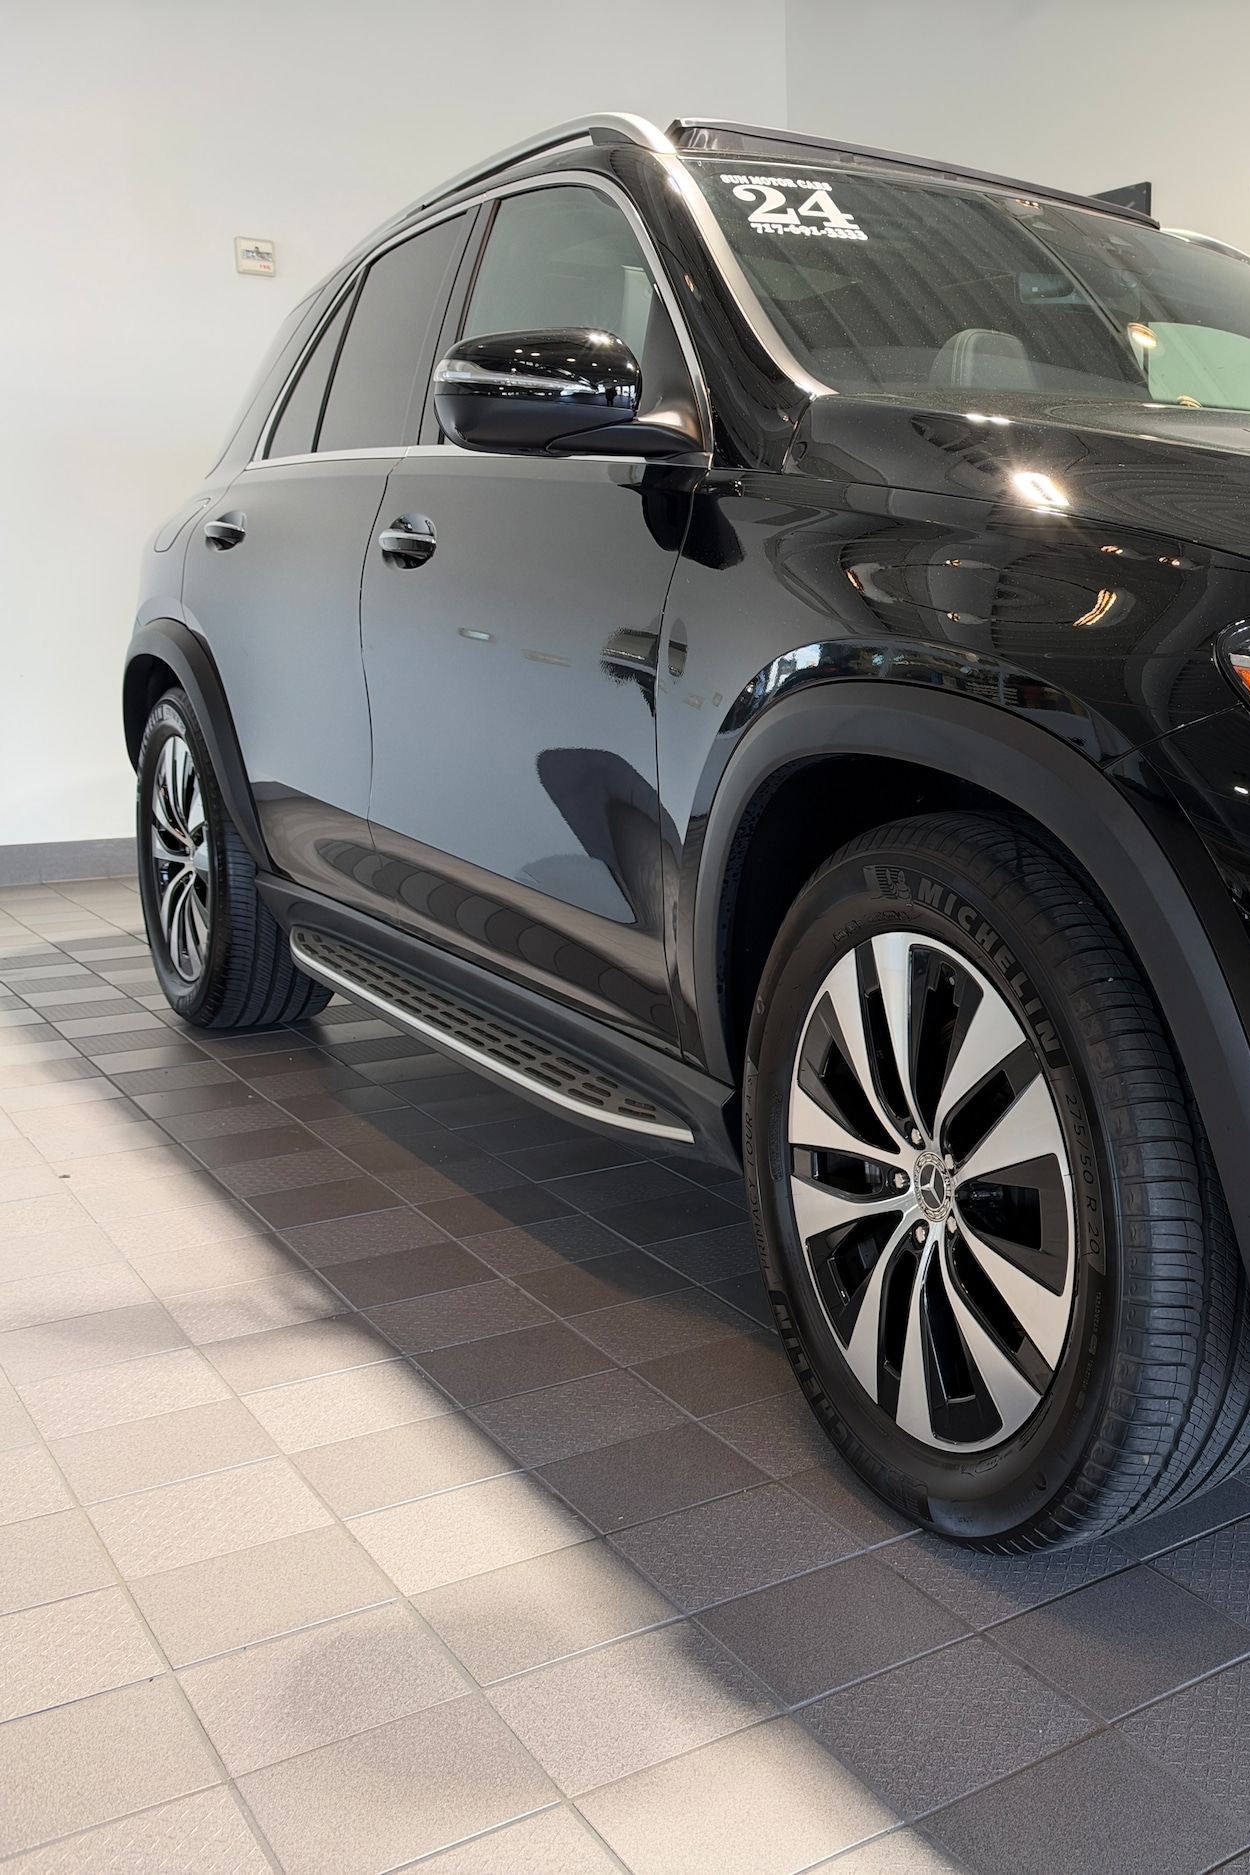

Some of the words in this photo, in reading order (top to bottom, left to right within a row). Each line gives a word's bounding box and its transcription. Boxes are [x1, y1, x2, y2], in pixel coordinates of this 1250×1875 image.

[719, 174, 749, 185] SUN
[748, 175, 797, 189] MOTOR
[797, 179, 833, 192] CARS
[732, 184, 860, 230] 24
[918, 877, 1061, 1055] MICHELIN
[745, 1112, 755, 1168] TOUR
[1065, 1094, 1094, 1184] 275/50
[748, 1178, 770, 1270] PRIMACY
[1085, 1195, 1097, 1212] R
[1088, 1221, 1101, 1255] 20
